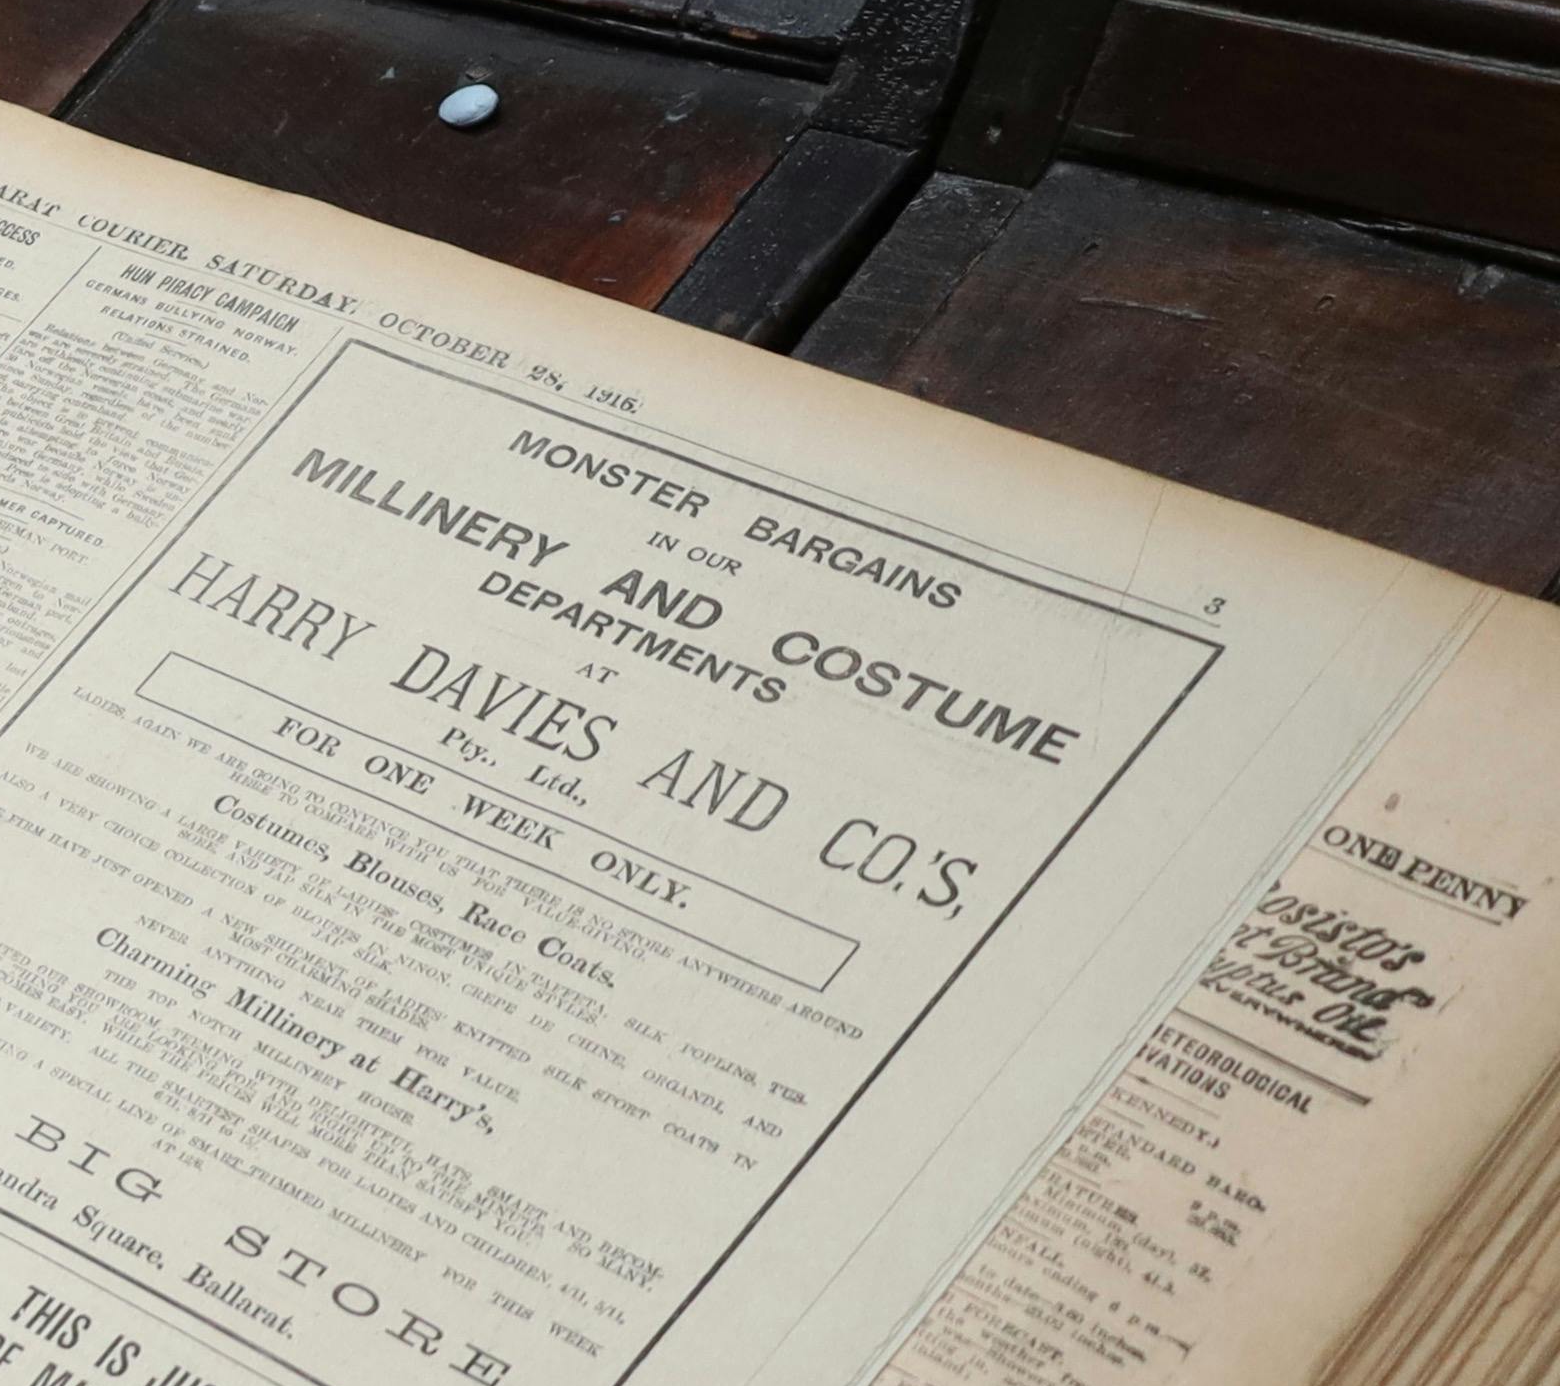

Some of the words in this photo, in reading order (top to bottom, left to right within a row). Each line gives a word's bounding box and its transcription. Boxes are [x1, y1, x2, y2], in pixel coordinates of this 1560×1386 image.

[84, 278, 149, 307] GERMANS
[153, 300, 227, 331] BULLYING
[231, 326, 298, 358] NORWAY.
[118, 262, 159, 287] HUN
[155, 274, 218, 303] PIRACY
[213, 290, 302, 334] CAMPAIGN
[377, 311, 512, 370] OCTOBER
[507, 428, 711, 520] MONSTER
[742, 514, 963, 610] BARGAINS
[645, 530, 682, 554] IN
[685, 545, 744, 578] OUR
[290, 447, 572, 569] MILLINERY
[598, 567, 725, 631] AND
[770, 630, 1082, 767] COSTUME
[476, 569, 788, 705] DEPARTMENTS
[1202, 595, 1228, 617] 3
[167, 550, 378, 662] HARRY
[388, 642, 620, 763] DAVIES
[635, 747, 791, 833] AND
[574, 661, 621, 685] AT
[271, 715, 343, 759] FOR
[363, 754, 437, 797] ONE
[462, 792, 565, 851] WEEK
[589, 849, 692, 910] ONLY.
[438, 725, 498, 768] Pty.,
[523, 763, 588, 808] Ltd.,
[212, 793, 331, 864] Costumes,
[342, 848, 445, 915] Blouses,
[457, 899, 528, 944] Race
[536, 935, 616, 990] Coats.
[1322, 824, 1404, 873] ONE
[1397, 855, 1529, 921] PENNY
[95, 926, 218, 1000] Charming
[224, 985, 347, 1061] Millinery
[347, 1051, 382, 1075] at
[388, 1064, 495, 1136] Harry's,
[13, 1113, 164, 1204] BIG
[9, 1283, 93, 1351] THIS
[92, 1333, 143, 1379] IS
[181, 1261, 294, 1341] Ballarat.
